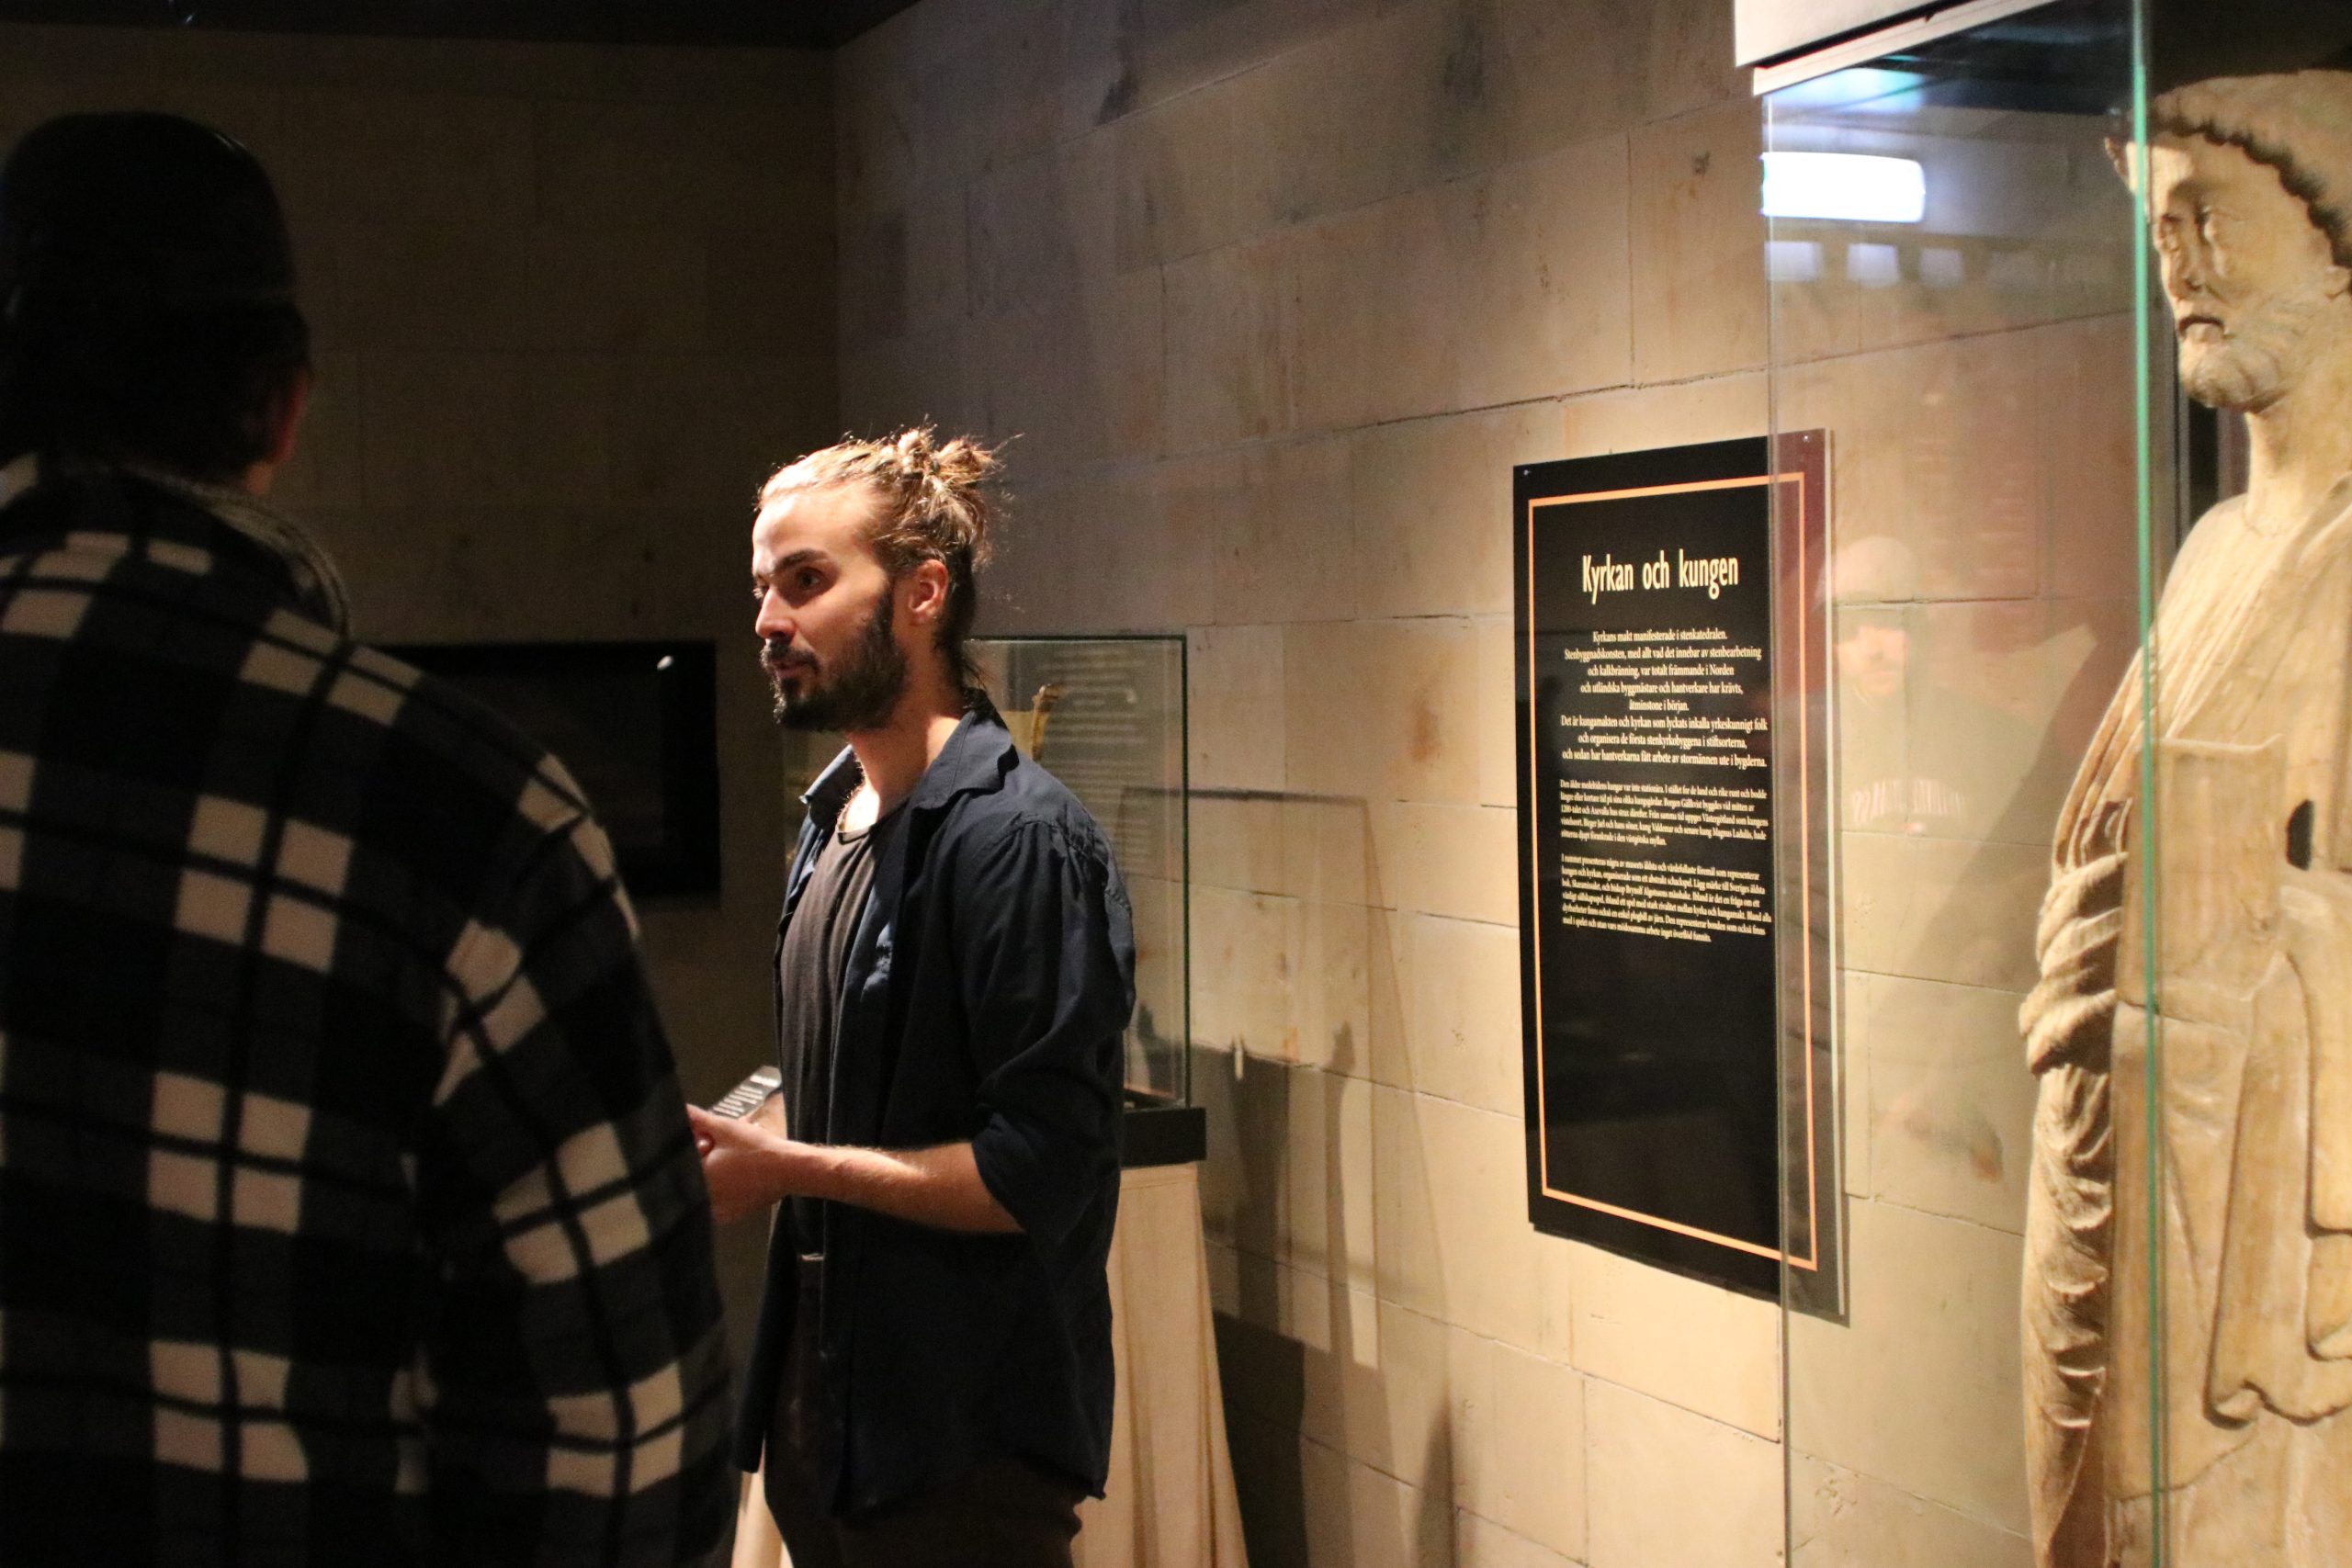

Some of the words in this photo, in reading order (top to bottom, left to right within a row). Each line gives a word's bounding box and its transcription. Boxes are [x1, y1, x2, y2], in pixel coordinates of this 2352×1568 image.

[1582, 553, 1634, 605] Kyrkan
[1642, 549, 1670, 590] och
[1679, 548, 1739, 600] kungen
[1593, 631, 1616, 644] Kyrkans
[1616, 631, 1633, 641] makt
[1633, 630, 1676, 641] manifesterade
[1676, 630, 1679, 640] i
[1679, 629, 1727, 640] stenkatedralen.
[1565, 649, 1626, 661] Stenbyggnadskonsten,
[1627, 648, 1641, 659] med
[1641, 648, 1652, 658] allt
[1652, 648, 1664, 658] vad
[1664, 648, 1675, 658] det
[1675, 648, 1700, 658] innebar
[1708, 647, 1761, 660] stenbearbetning
[1588, 665, 1599, 676] och
[1599, 665, 1639, 678] kalkbränning,
[1639, 668, 1650, 676] var
[1650, 664, 1668, 676] totalt
[1668, 664, 1704, 676] främmande
[1705, 664, 1708, 676] i
[1709, 664, 1734, 676] Norden
[1580, 682, 1591, 693] och
[1592, 682, 1620, 693] utländska
[1620, 682, 1657, 695] byggmästare
[1657, 682, 1670, 693] och
[1670, 682, 1708, 693] hantverkare
[1708, 682, 1720, 693] har
[1720, 682, 1743, 694] krävts,
[1629, 699, 1663, 710] åtminstone
[1663, 700, 1666, 710] i
[1667, 700, 1689, 714] början.
[1561, 715, 1571, 726] Det
[1572, 716, 1578, 726] är
[1578, 716, 1617, 729] kungamakten
[1617, 716, 1630, 727] och
[1630, 716, 1652, 730] kyrkan
[1666, 717, 1688, 731] lyckats
[1688, 718, 1710, 728] inkalla
[1710, 718, 1753, 733] yrkeskunnigt
[1754, 719, 1768, 730] folk
[1577, 732, 1589, 742] och
[1589, 732, 1620, 746] organisera
[1620, 733, 1628, 743] de
[1628, 733, 1646, 744] första
[1702, 736, 1705, 746] i
[1706, 736, 1747, 749] stiftsorterna,
[1562, 748, 1573, 759] och
[1573, 749, 1589, 759] sedan
[1589, 749, 1600, 760] har
[1600, 750, 1640, 761] hantverkarna
[1640, 751, 1651, 761] fått
[1651, 751, 1671, 762] arbete
[1671, 755, 1679, 763] av
[1679, 752, 1718, 765] stormännen
[1718, 756, 1729, 765] ute
[1729, 755, 1733, 765] i
[1734, 755, 1766, 770] bygderna.
